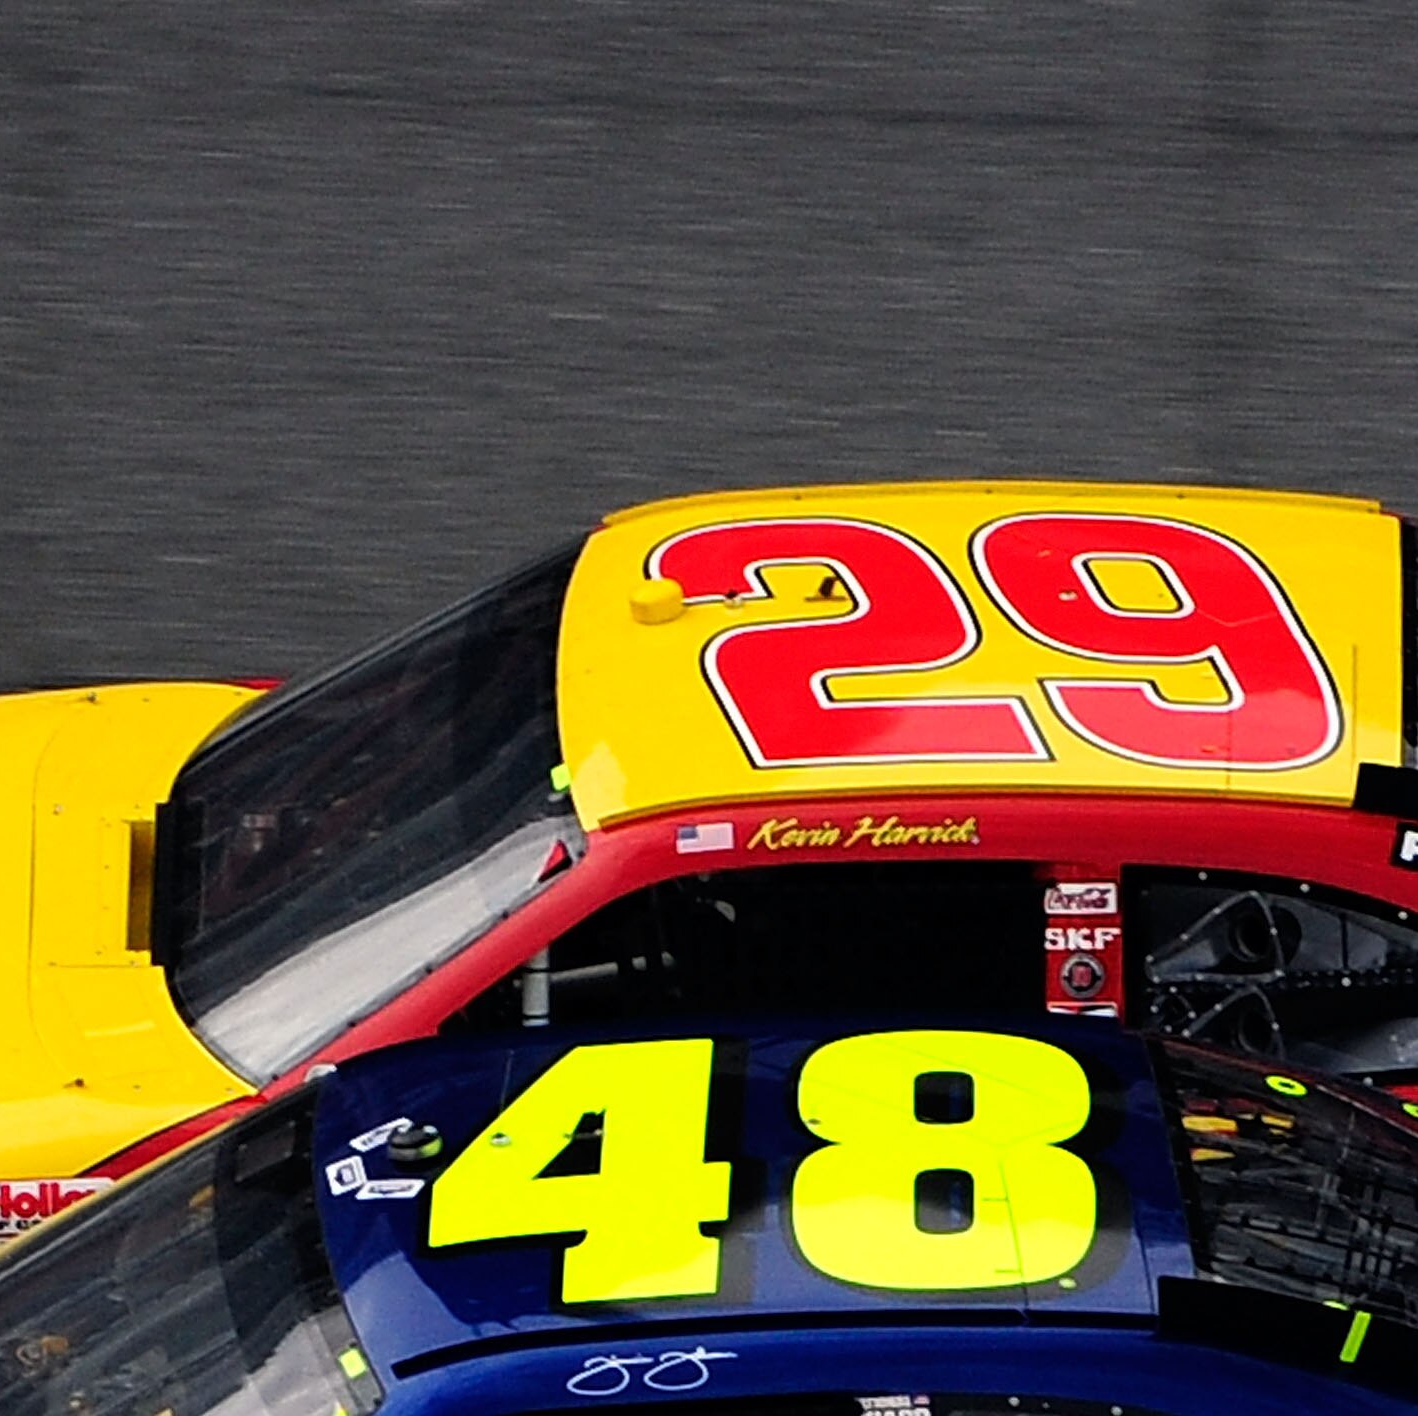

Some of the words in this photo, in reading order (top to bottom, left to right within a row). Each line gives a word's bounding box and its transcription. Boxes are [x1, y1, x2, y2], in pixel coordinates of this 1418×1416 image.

[643, 511, 1346, 773] 29
[746, 816, 842, 851] Kevin
[1044, 926, 1122, 952] SKF
[427, 1030, 1097, 1304] 48
